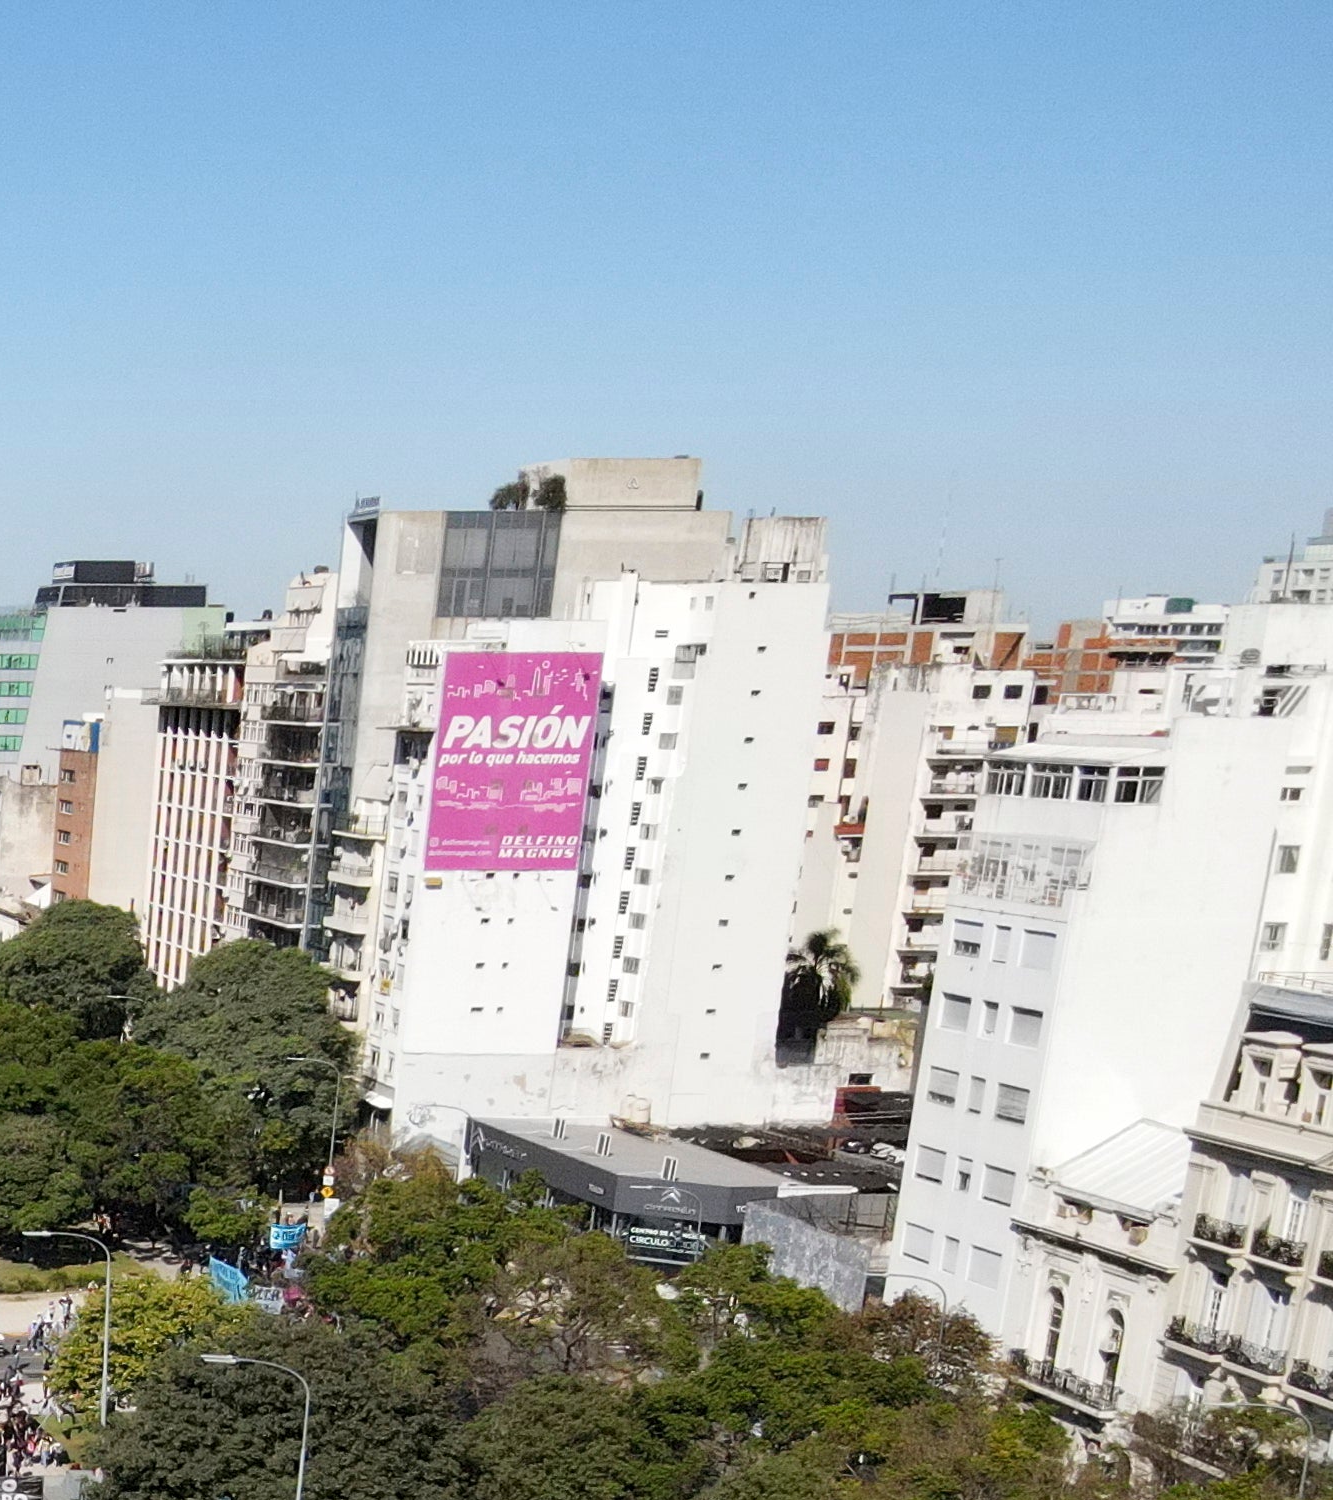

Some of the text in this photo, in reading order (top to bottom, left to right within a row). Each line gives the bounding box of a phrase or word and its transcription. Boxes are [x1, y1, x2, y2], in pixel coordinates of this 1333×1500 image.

[442, 705, 592, 749] PASIÓN
[439, 750, 580, 767] por lo que hacemos
[501, 836, 578, 846] DELFINO
[498, 848, 575, 859] MAGNUS
[630, 1226, 658, 1236] CENTRO
